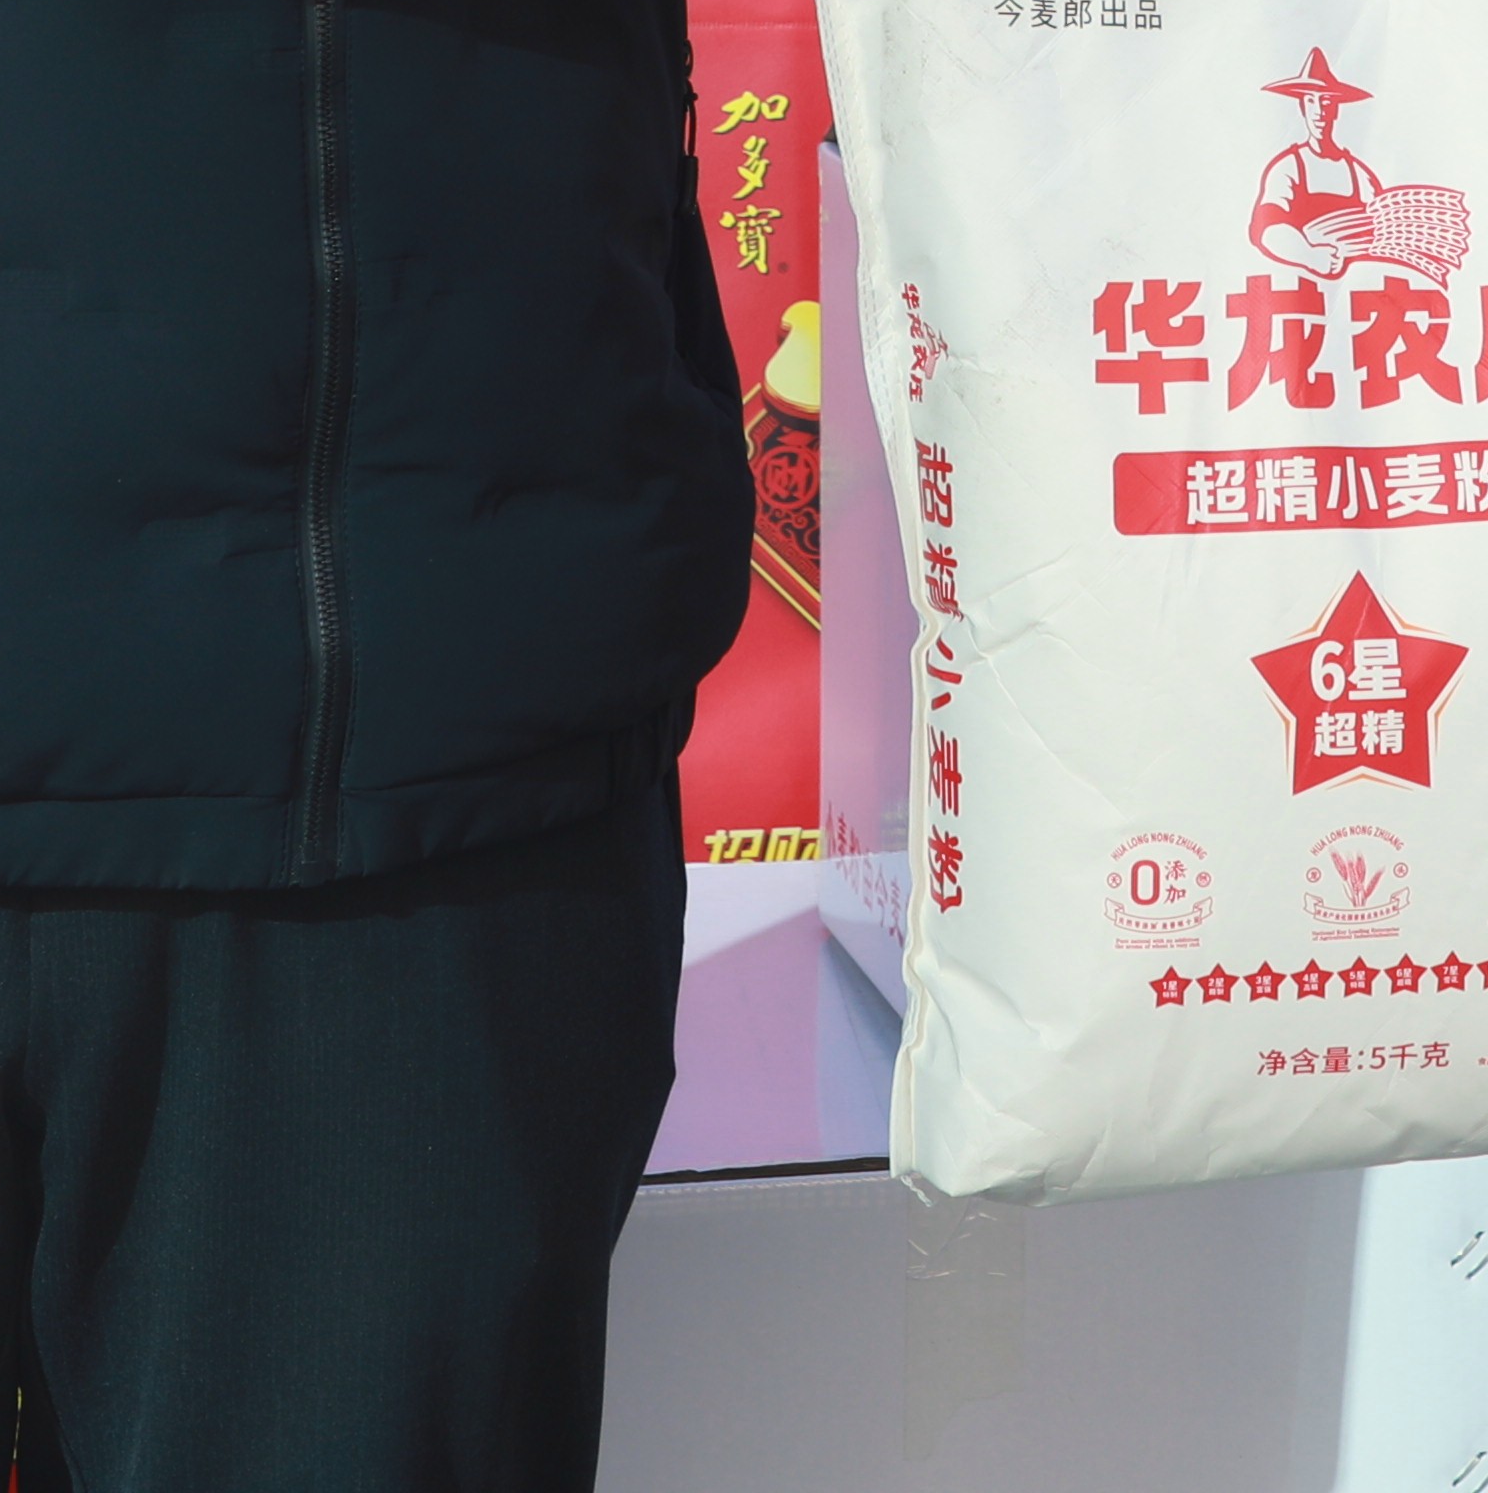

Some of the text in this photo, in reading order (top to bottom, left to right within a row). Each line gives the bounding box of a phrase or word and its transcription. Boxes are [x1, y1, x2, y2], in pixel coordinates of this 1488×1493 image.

[914, 437, 965, 914] 超精小麦粉
[1310, 637, 1408, 703] 6星
[1313, 708, 1406, 758] 超精
[1310, 839, 1328, 857] HUA
[1325, 826, 1348, 844] LONG
[1349, 824, 1373, 836] NONG
[1111, 832, 1208, 862] HUA LONG NONG ZHUANG
[1349, 970, 1366, 981] 5星
[1396, 968, 1412, 979] 6星
[1443, 965, 1459, 976] 7星
[1208, 977, 1224, 988] 2星
[1255, 975, 1272, 986] 3星
[1302, 973, 1319, 984] 4星
[1163, 980, 1178, 991] 1星
